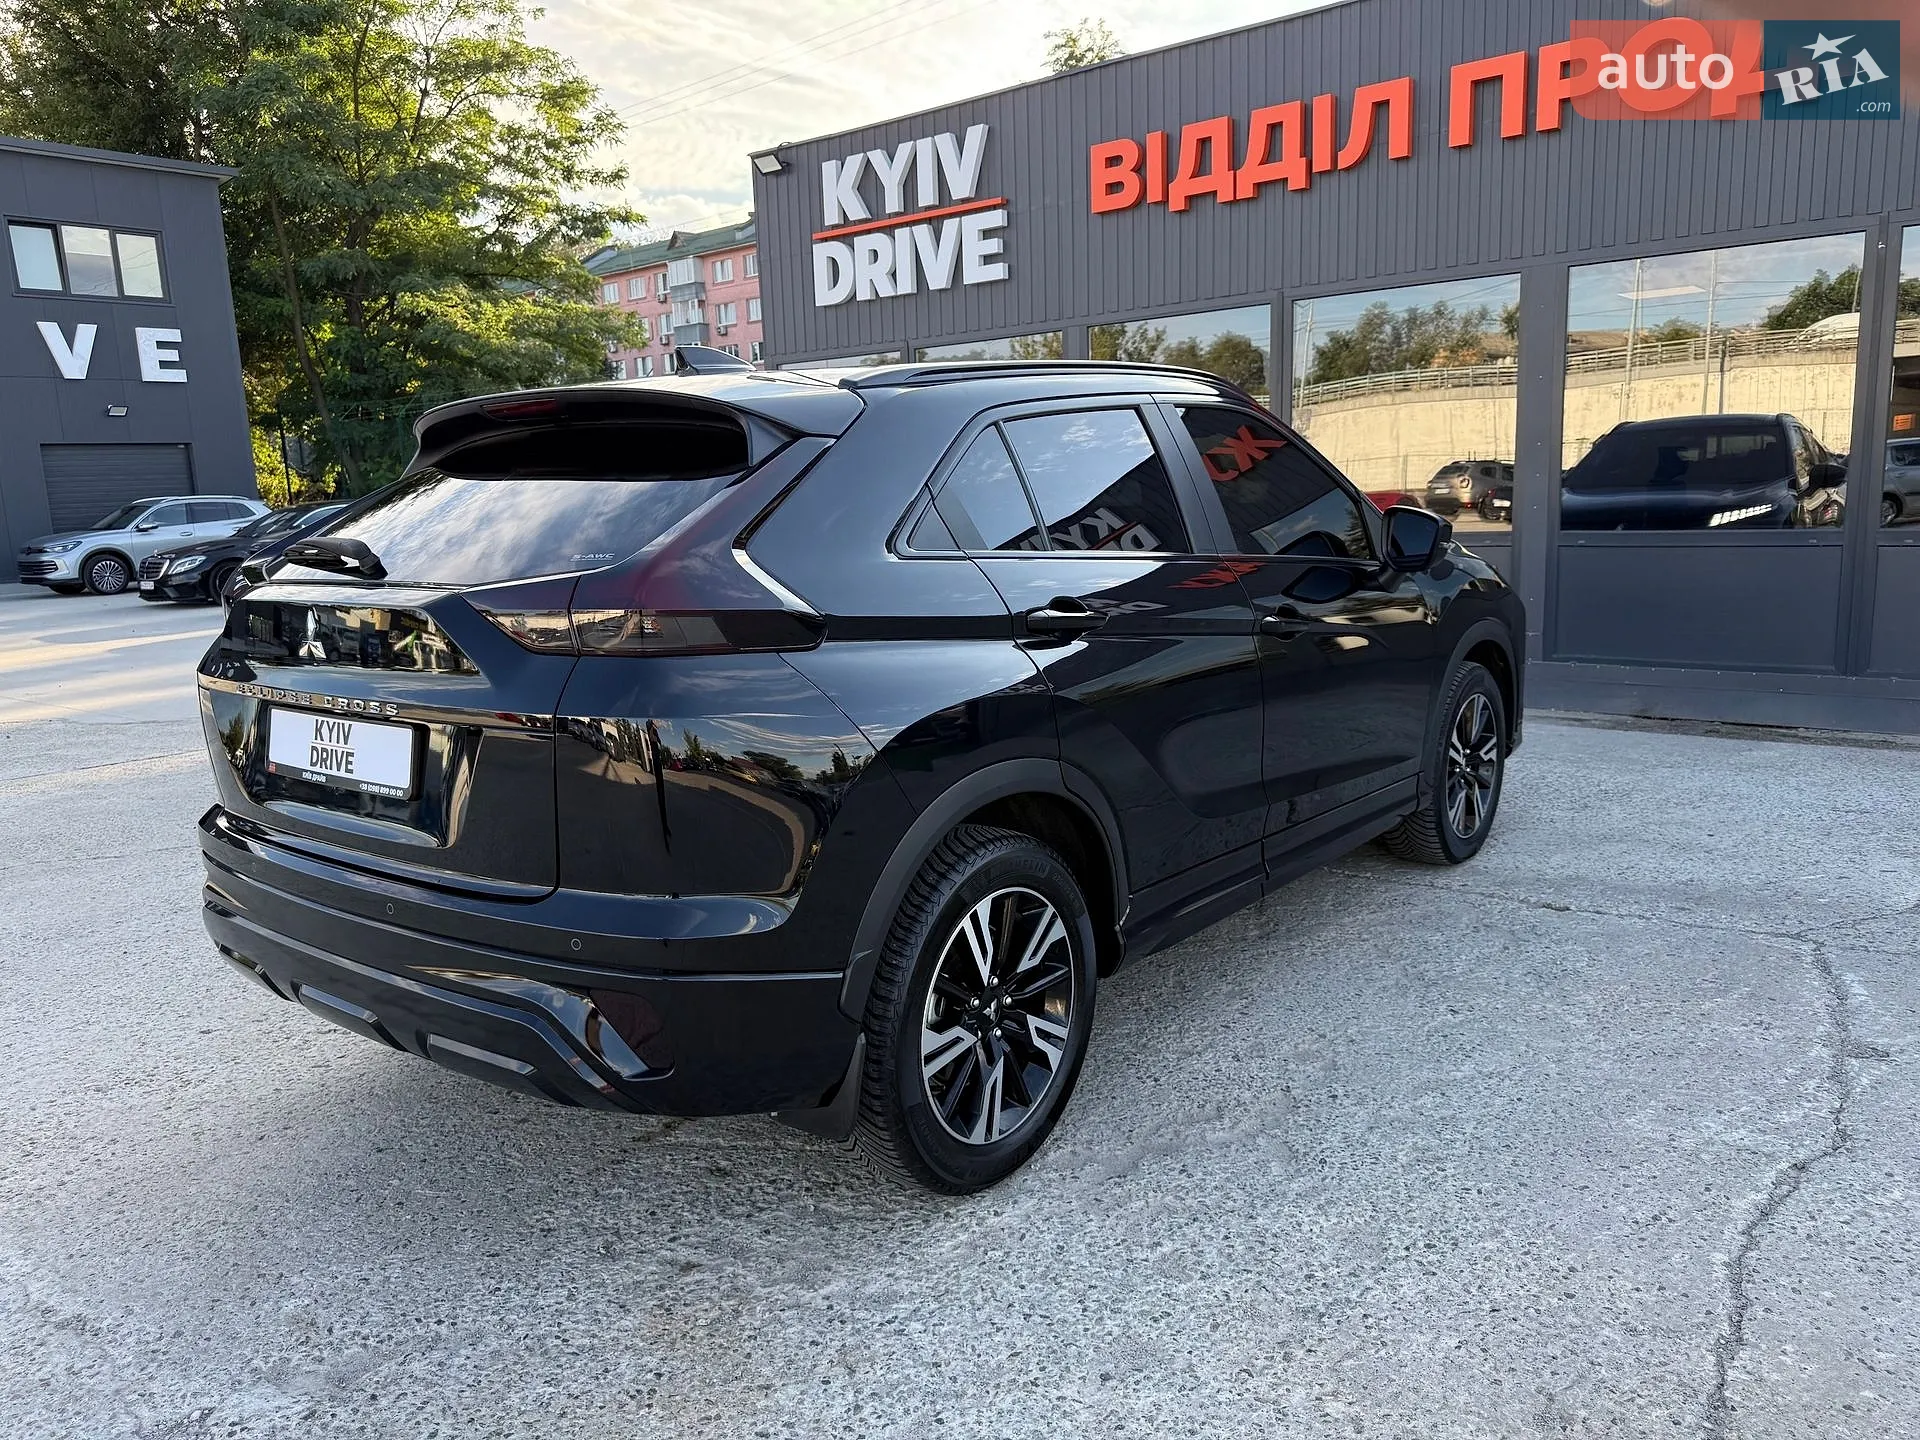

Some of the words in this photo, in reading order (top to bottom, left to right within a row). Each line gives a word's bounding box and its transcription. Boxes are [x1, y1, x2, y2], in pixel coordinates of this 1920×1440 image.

[1090, 76, 1414, 213] ВІДДІЛ
[1448, 16, 1820, 149] ПРОД
[821, 123, 990, 226] KYIV
[812, 208, 1009, 307] DRIVE
[236, 683, 312, 705] ECLIPSE
[323, 696, 399, 716] CROSS
[314, 719, 353, 745] KYIV
[309, 745, 355, 775] DRIVE
